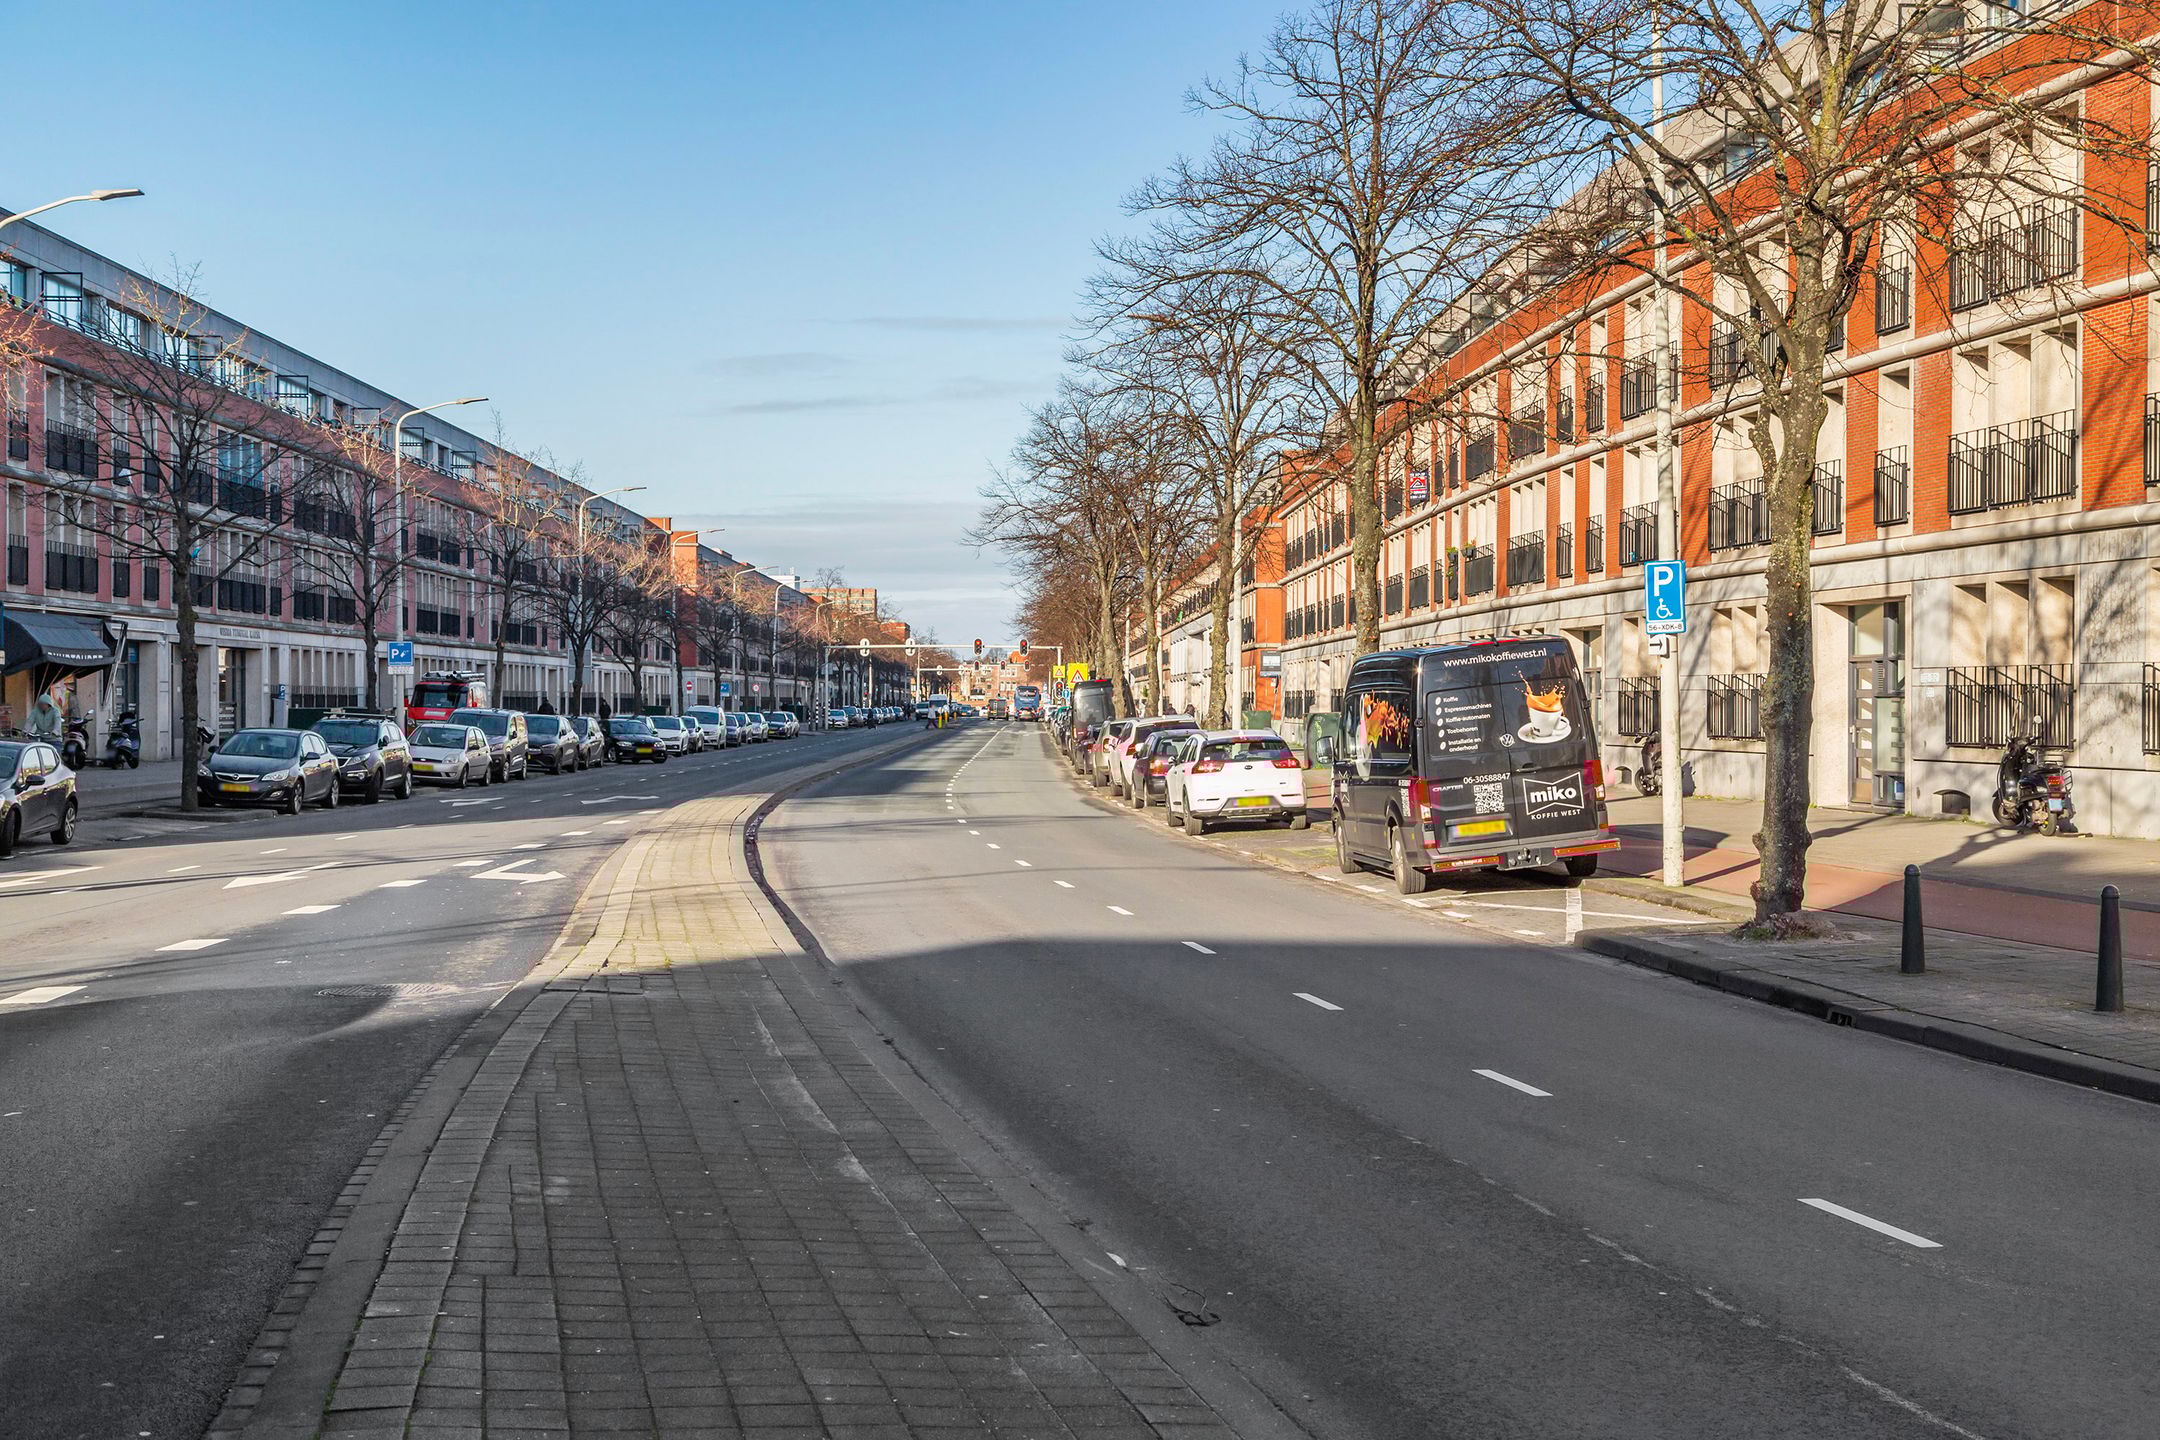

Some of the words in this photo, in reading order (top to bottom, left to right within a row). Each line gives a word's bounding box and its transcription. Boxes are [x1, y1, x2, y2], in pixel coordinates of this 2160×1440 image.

[1654, 566, 1673, 597] P
[1648, 623, 1682, 631] 56-XDK-8
[391, 649, 399, 659] P
[1443, 648, 1547, 667] www.mikokoffiewest.nl
[1446, 726, 1478, 735] Toebehoren
[1448, 738, 1473, 746] Installatie
[1449, 744, 1478, 753] onderhoud
[1463, 772, 1511, 785] 06-30588847
[1530, 786, 1577, 804] miko
[1531, 811, 1558, 820] KOFFIE
[1561, 809, 1581, 817] WEST
